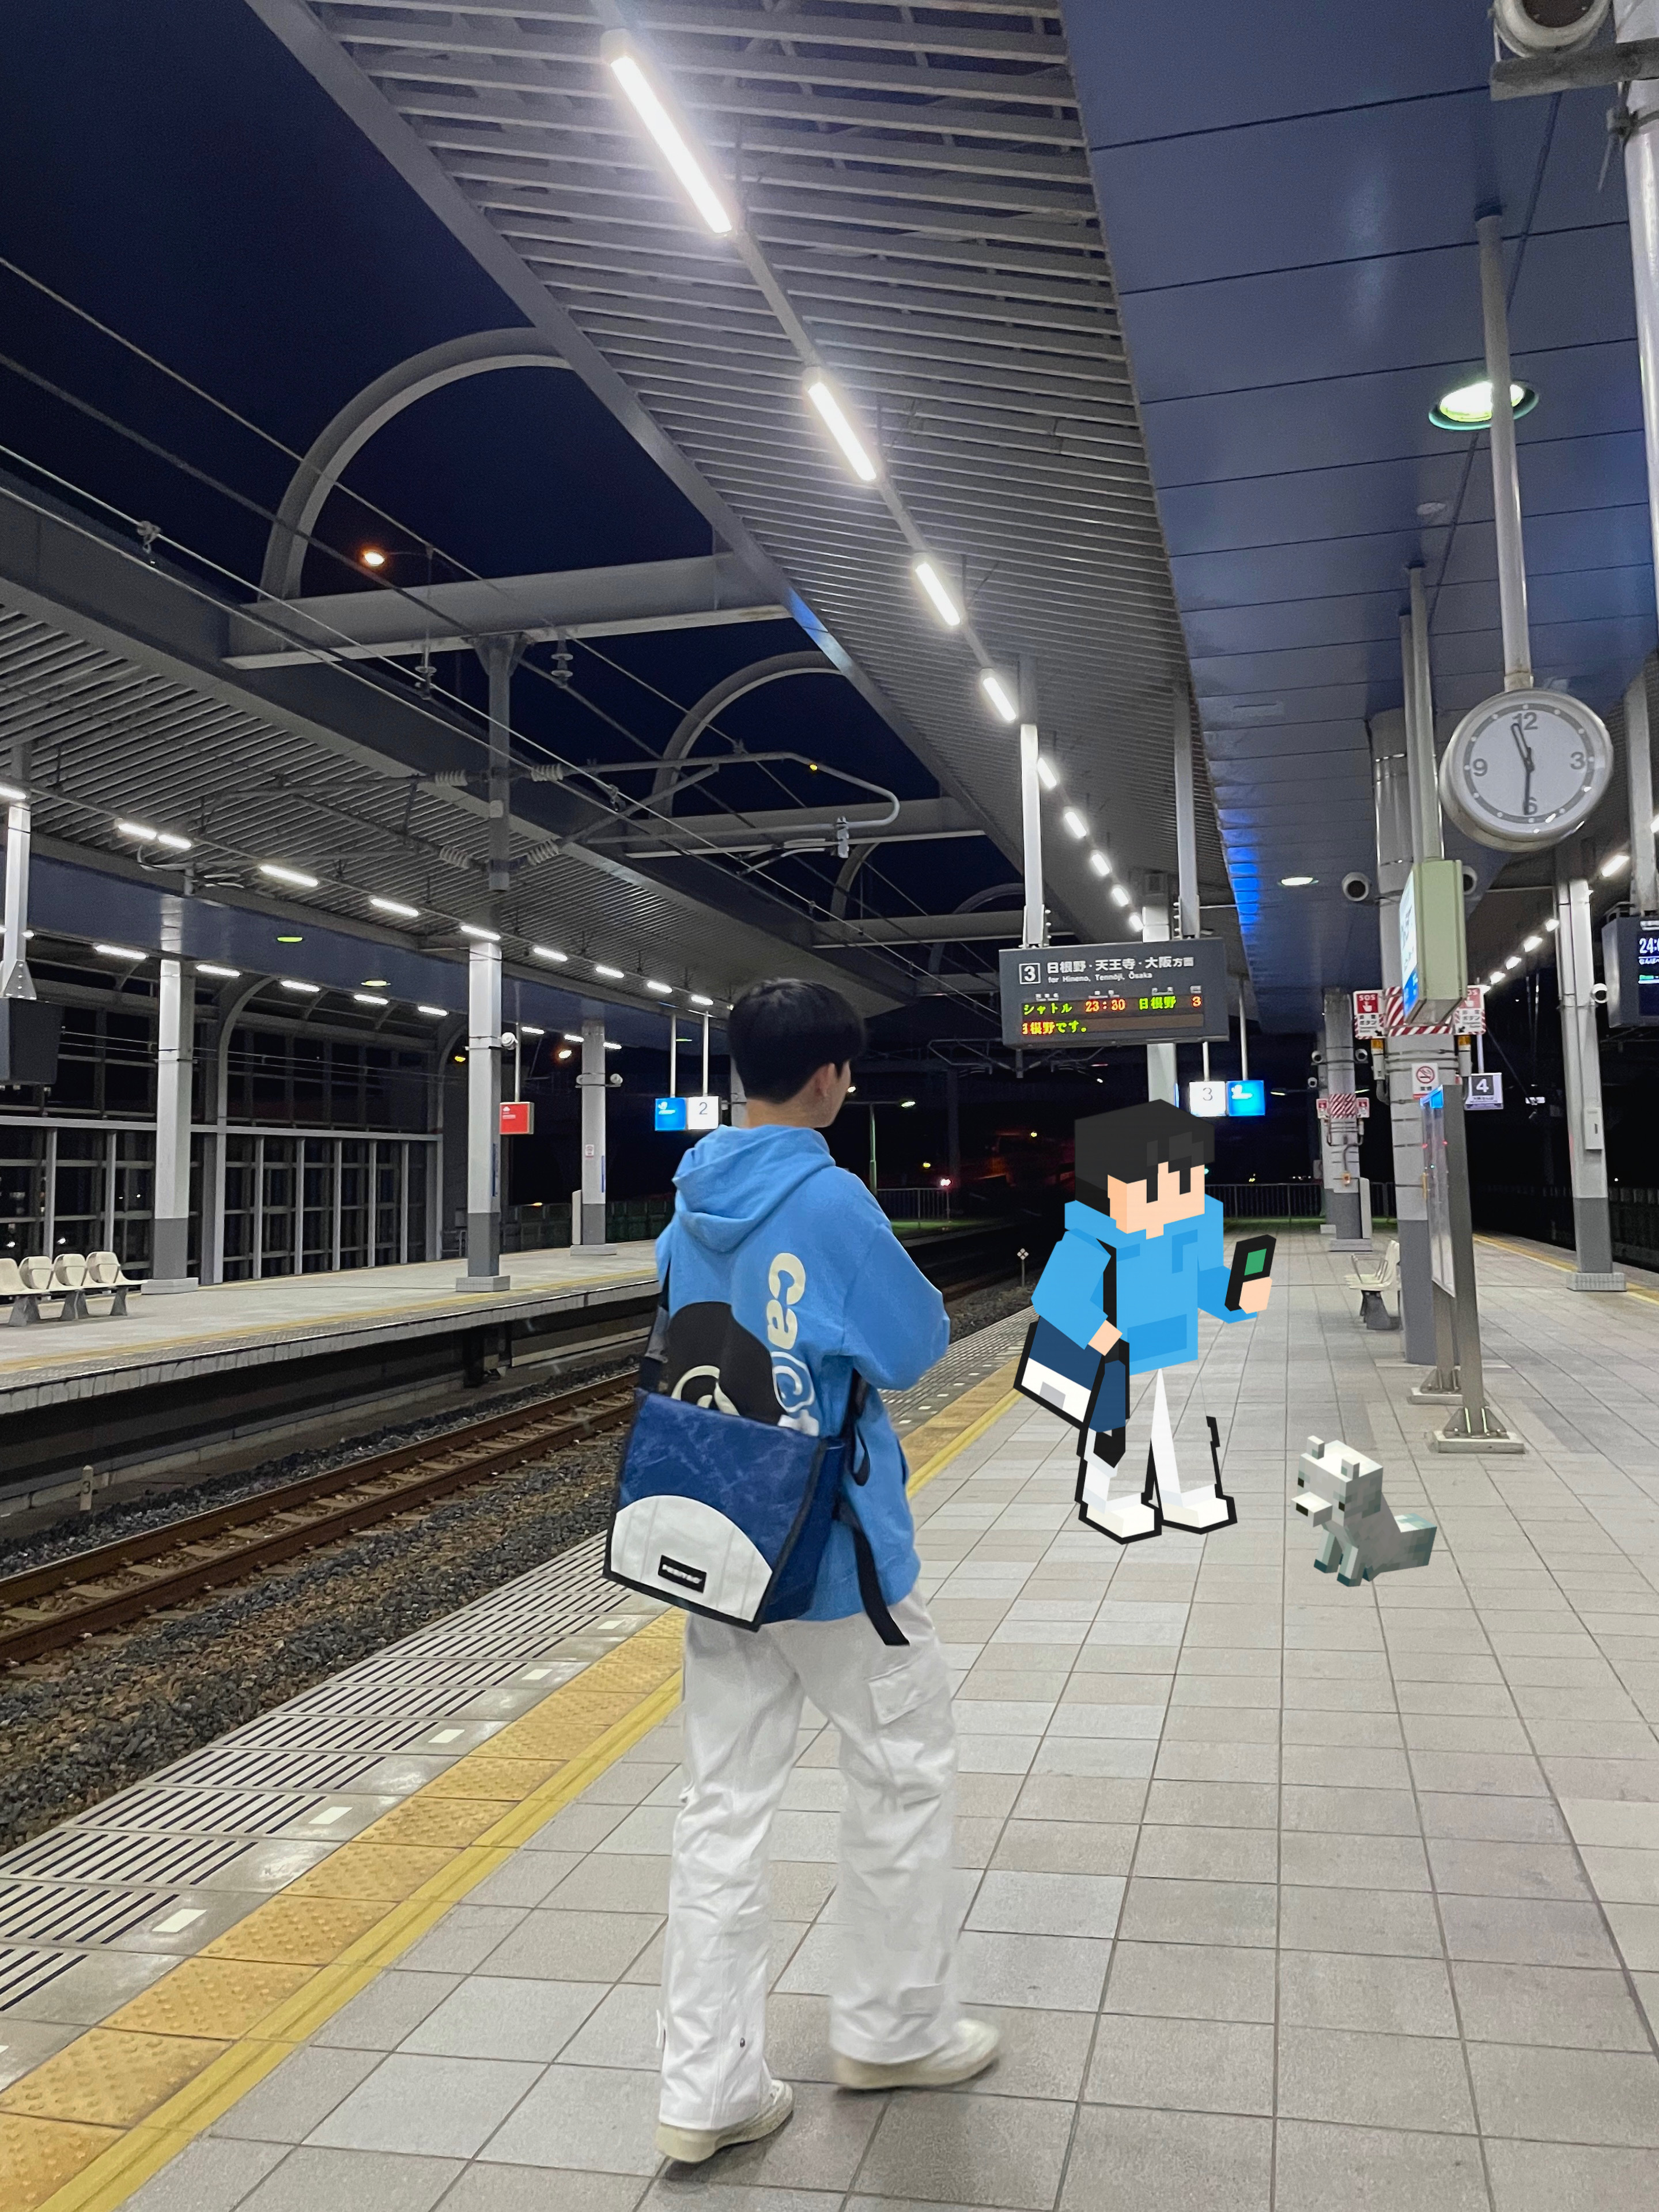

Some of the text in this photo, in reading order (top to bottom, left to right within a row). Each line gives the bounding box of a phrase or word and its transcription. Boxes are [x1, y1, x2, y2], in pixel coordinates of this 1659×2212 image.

[1512, 712, 1538, 731] 12
[1472, 758, 1488, 777] 9
[1569, 751, 1585, 770] 3
[1639, 937, 1659, 954] 24:
[1023, 965, 1036, 982] 3
[1023, 995, 1202, 1015] シャトル 23:30 日根野 3
[1202, 1087, 1213, 1101] 3
[1476, 1078, 1490, 1093] 4
[698, 1101, 708, 1115] 2
